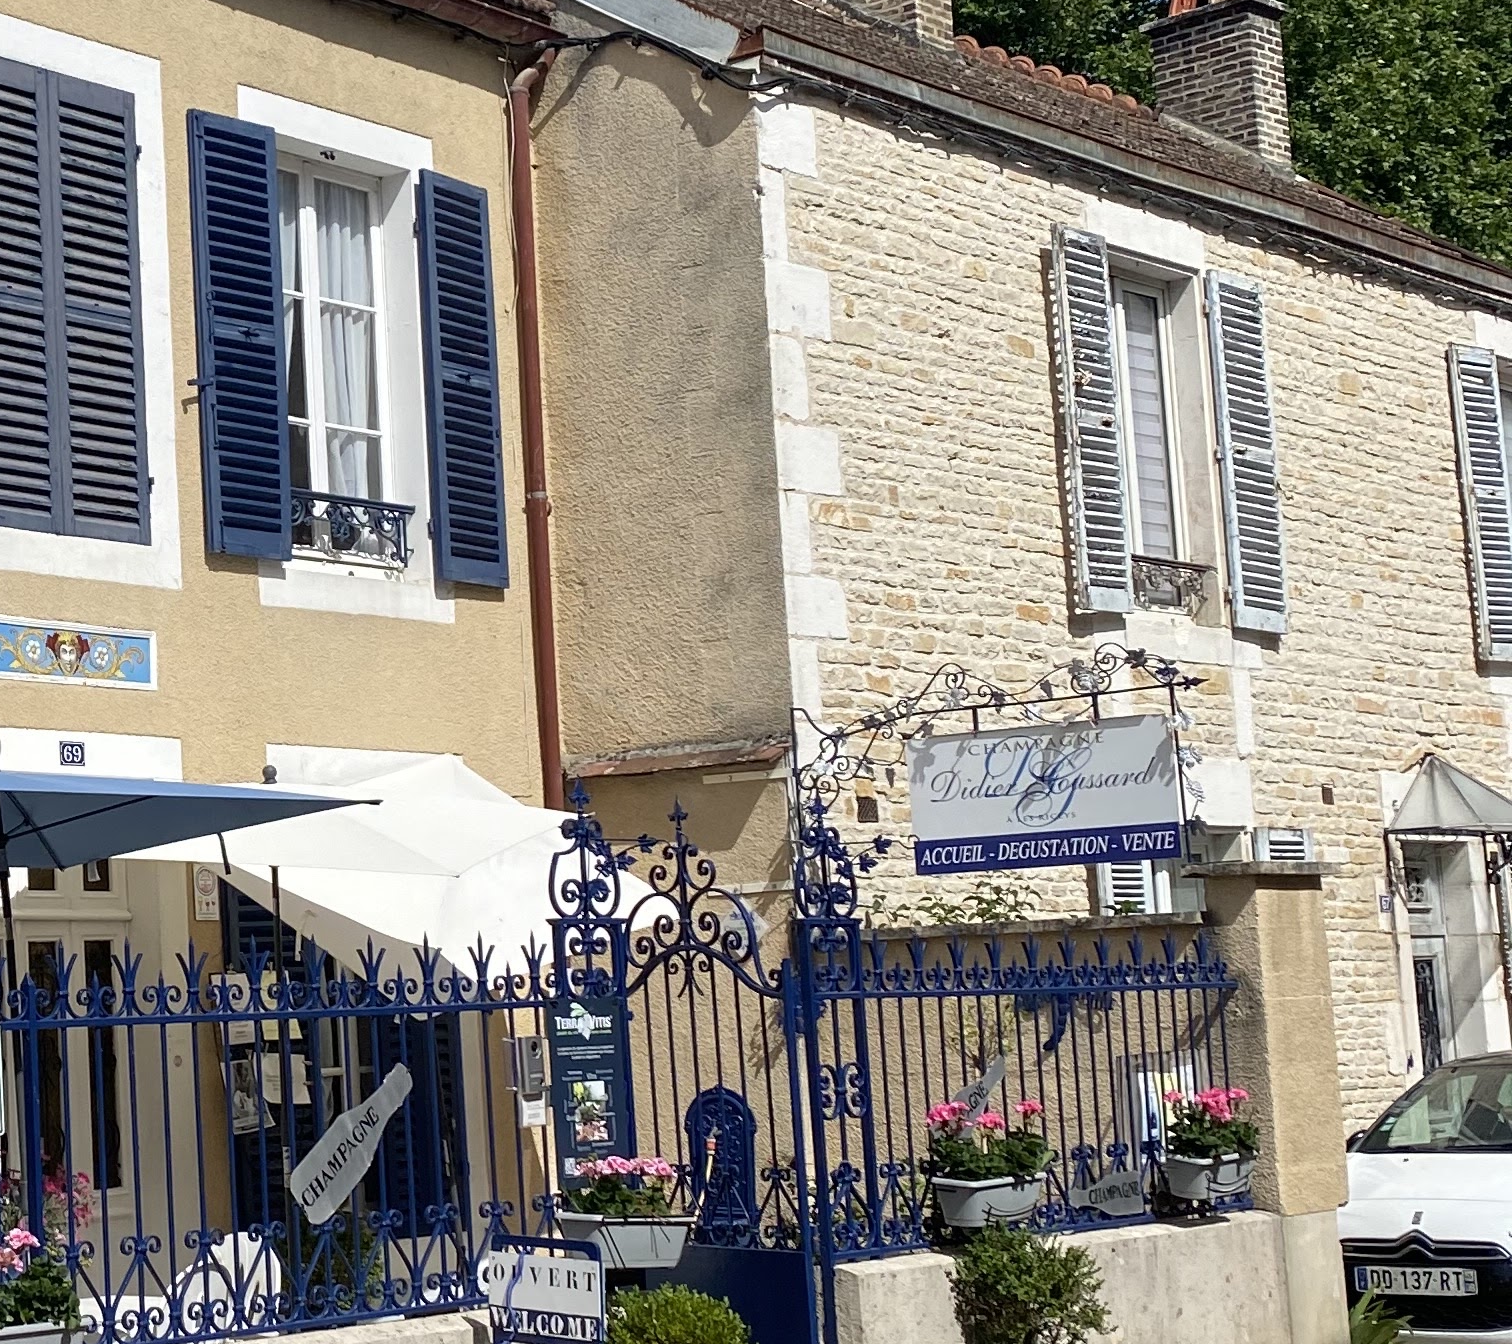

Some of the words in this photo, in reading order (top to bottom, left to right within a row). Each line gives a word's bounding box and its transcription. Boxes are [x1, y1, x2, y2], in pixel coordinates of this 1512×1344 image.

[63, 745, 82, 763] 69
[967, 731, 1105, 757] CHAMPAGNE
[930, 770, 1018, 803] Didier
[921, 845, 986, 867] ACCUEIL
[997, 835, 1109, 862] DEGUSTATION
[1121, 831, 1175, 853] VENTE
[301, 1106, 380, 1208] CHAMPAGNE
